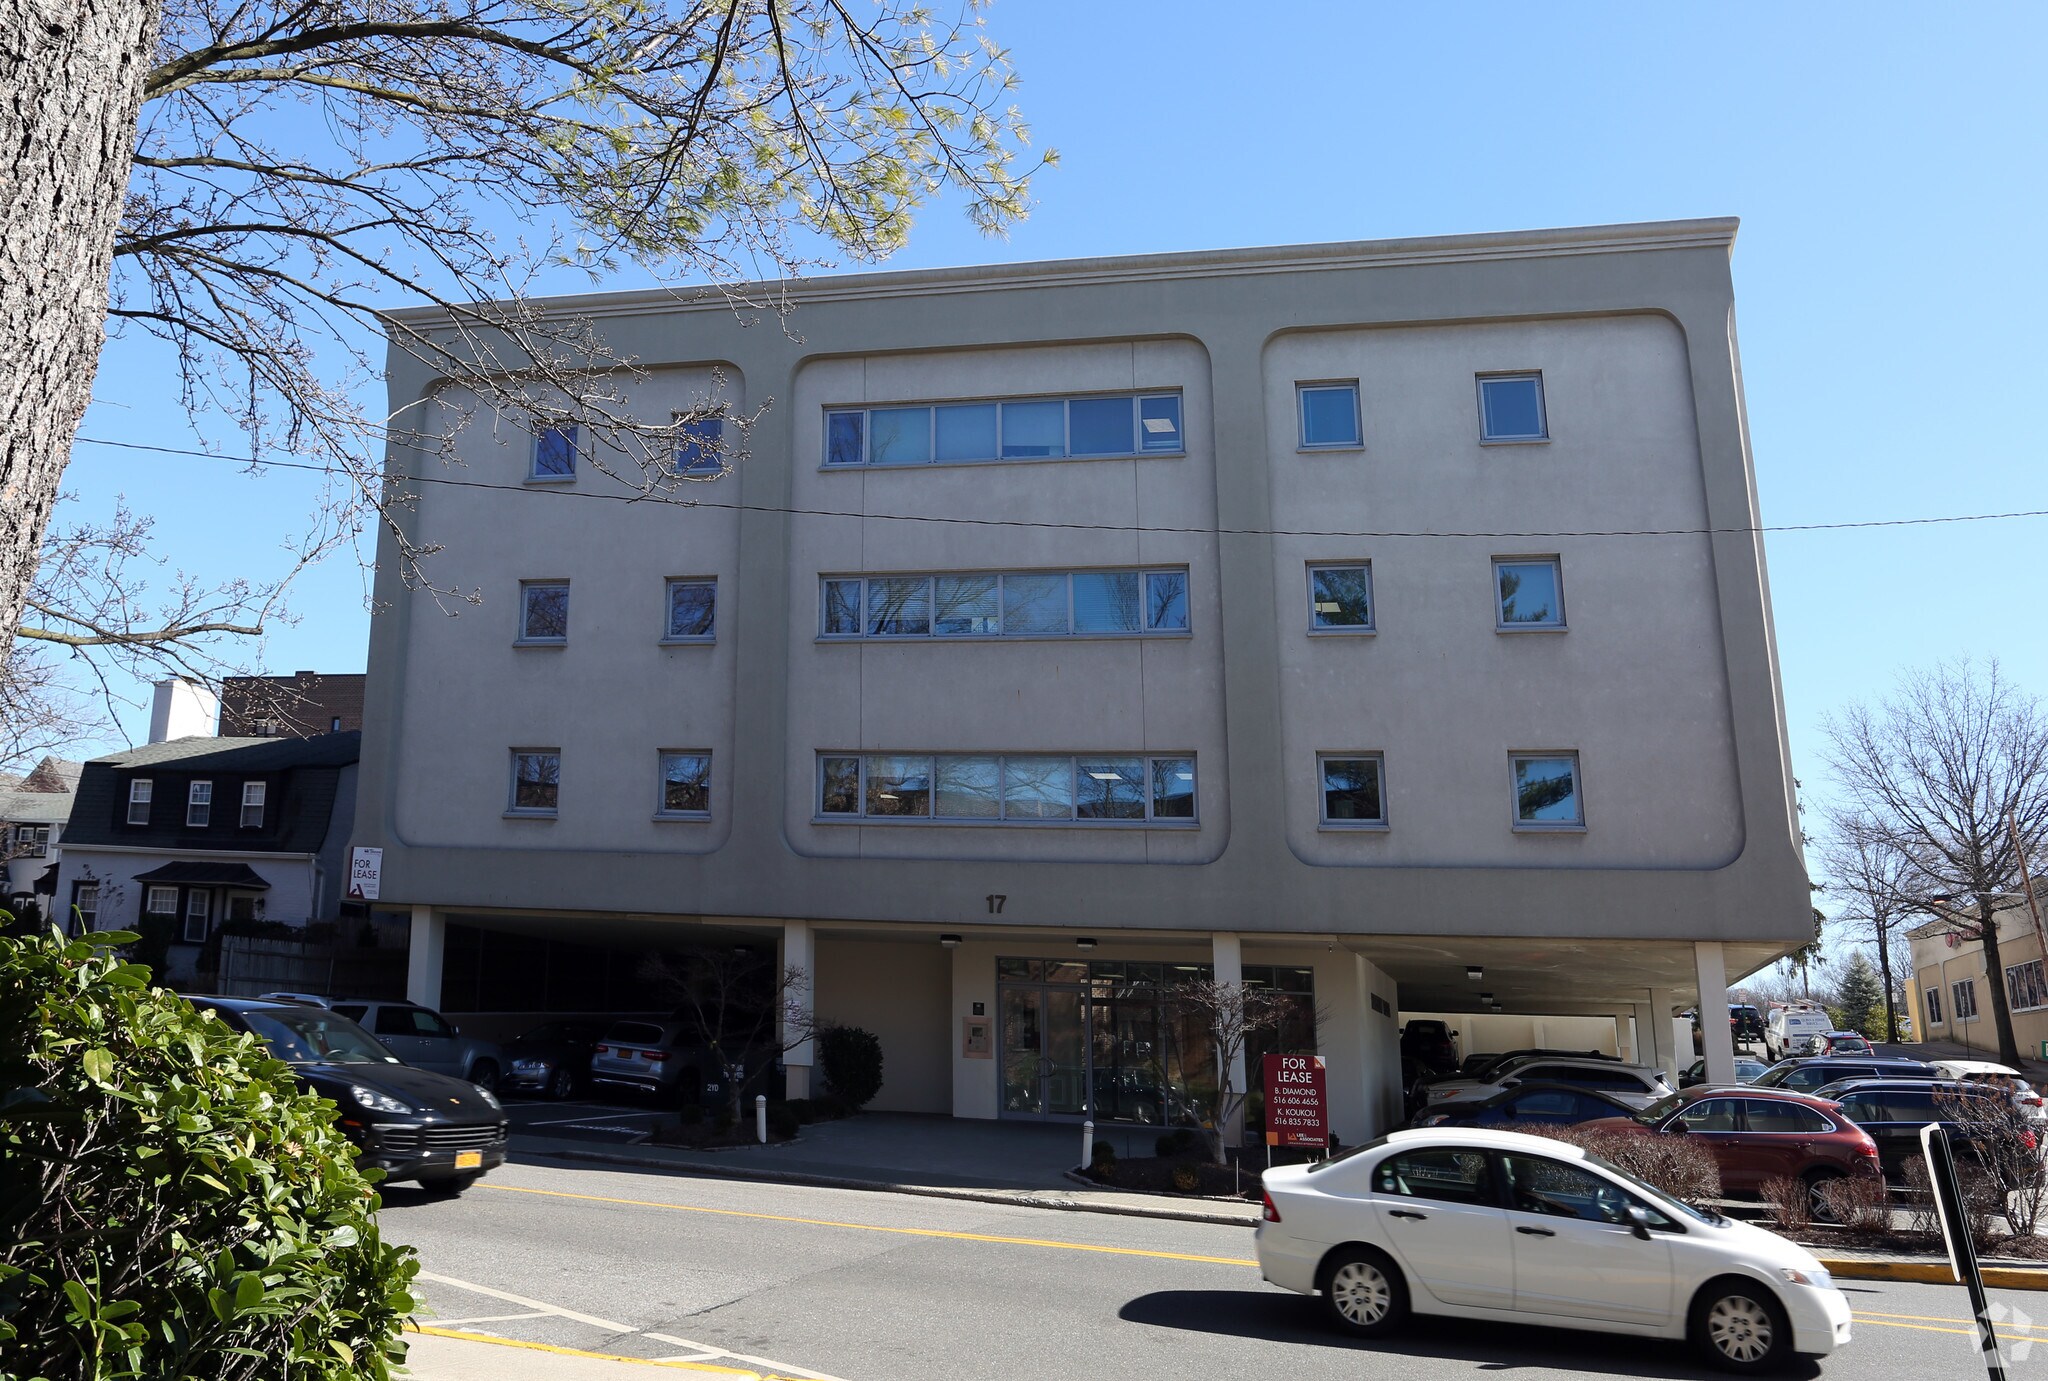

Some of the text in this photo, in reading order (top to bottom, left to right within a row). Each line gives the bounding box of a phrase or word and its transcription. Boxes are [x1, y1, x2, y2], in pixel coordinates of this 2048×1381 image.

[354, 859, 371, 868] FOR
[353, 869, 377, 879] LEASE
[986, 894, 1007, 913] 17
[1282, 1058, 1306, 1070] FOR
[1277, 1071, 1312, 1083] LEASE
[1274, 1087, 1316, 1096] B. DIAMOND
[1273, 1096, 1319, 1106] 516 606 4656
[1277, 1108, 1316, 1117] K. KOUKOU
[1274, 1117, 1320, 1127] 516 835 7833
